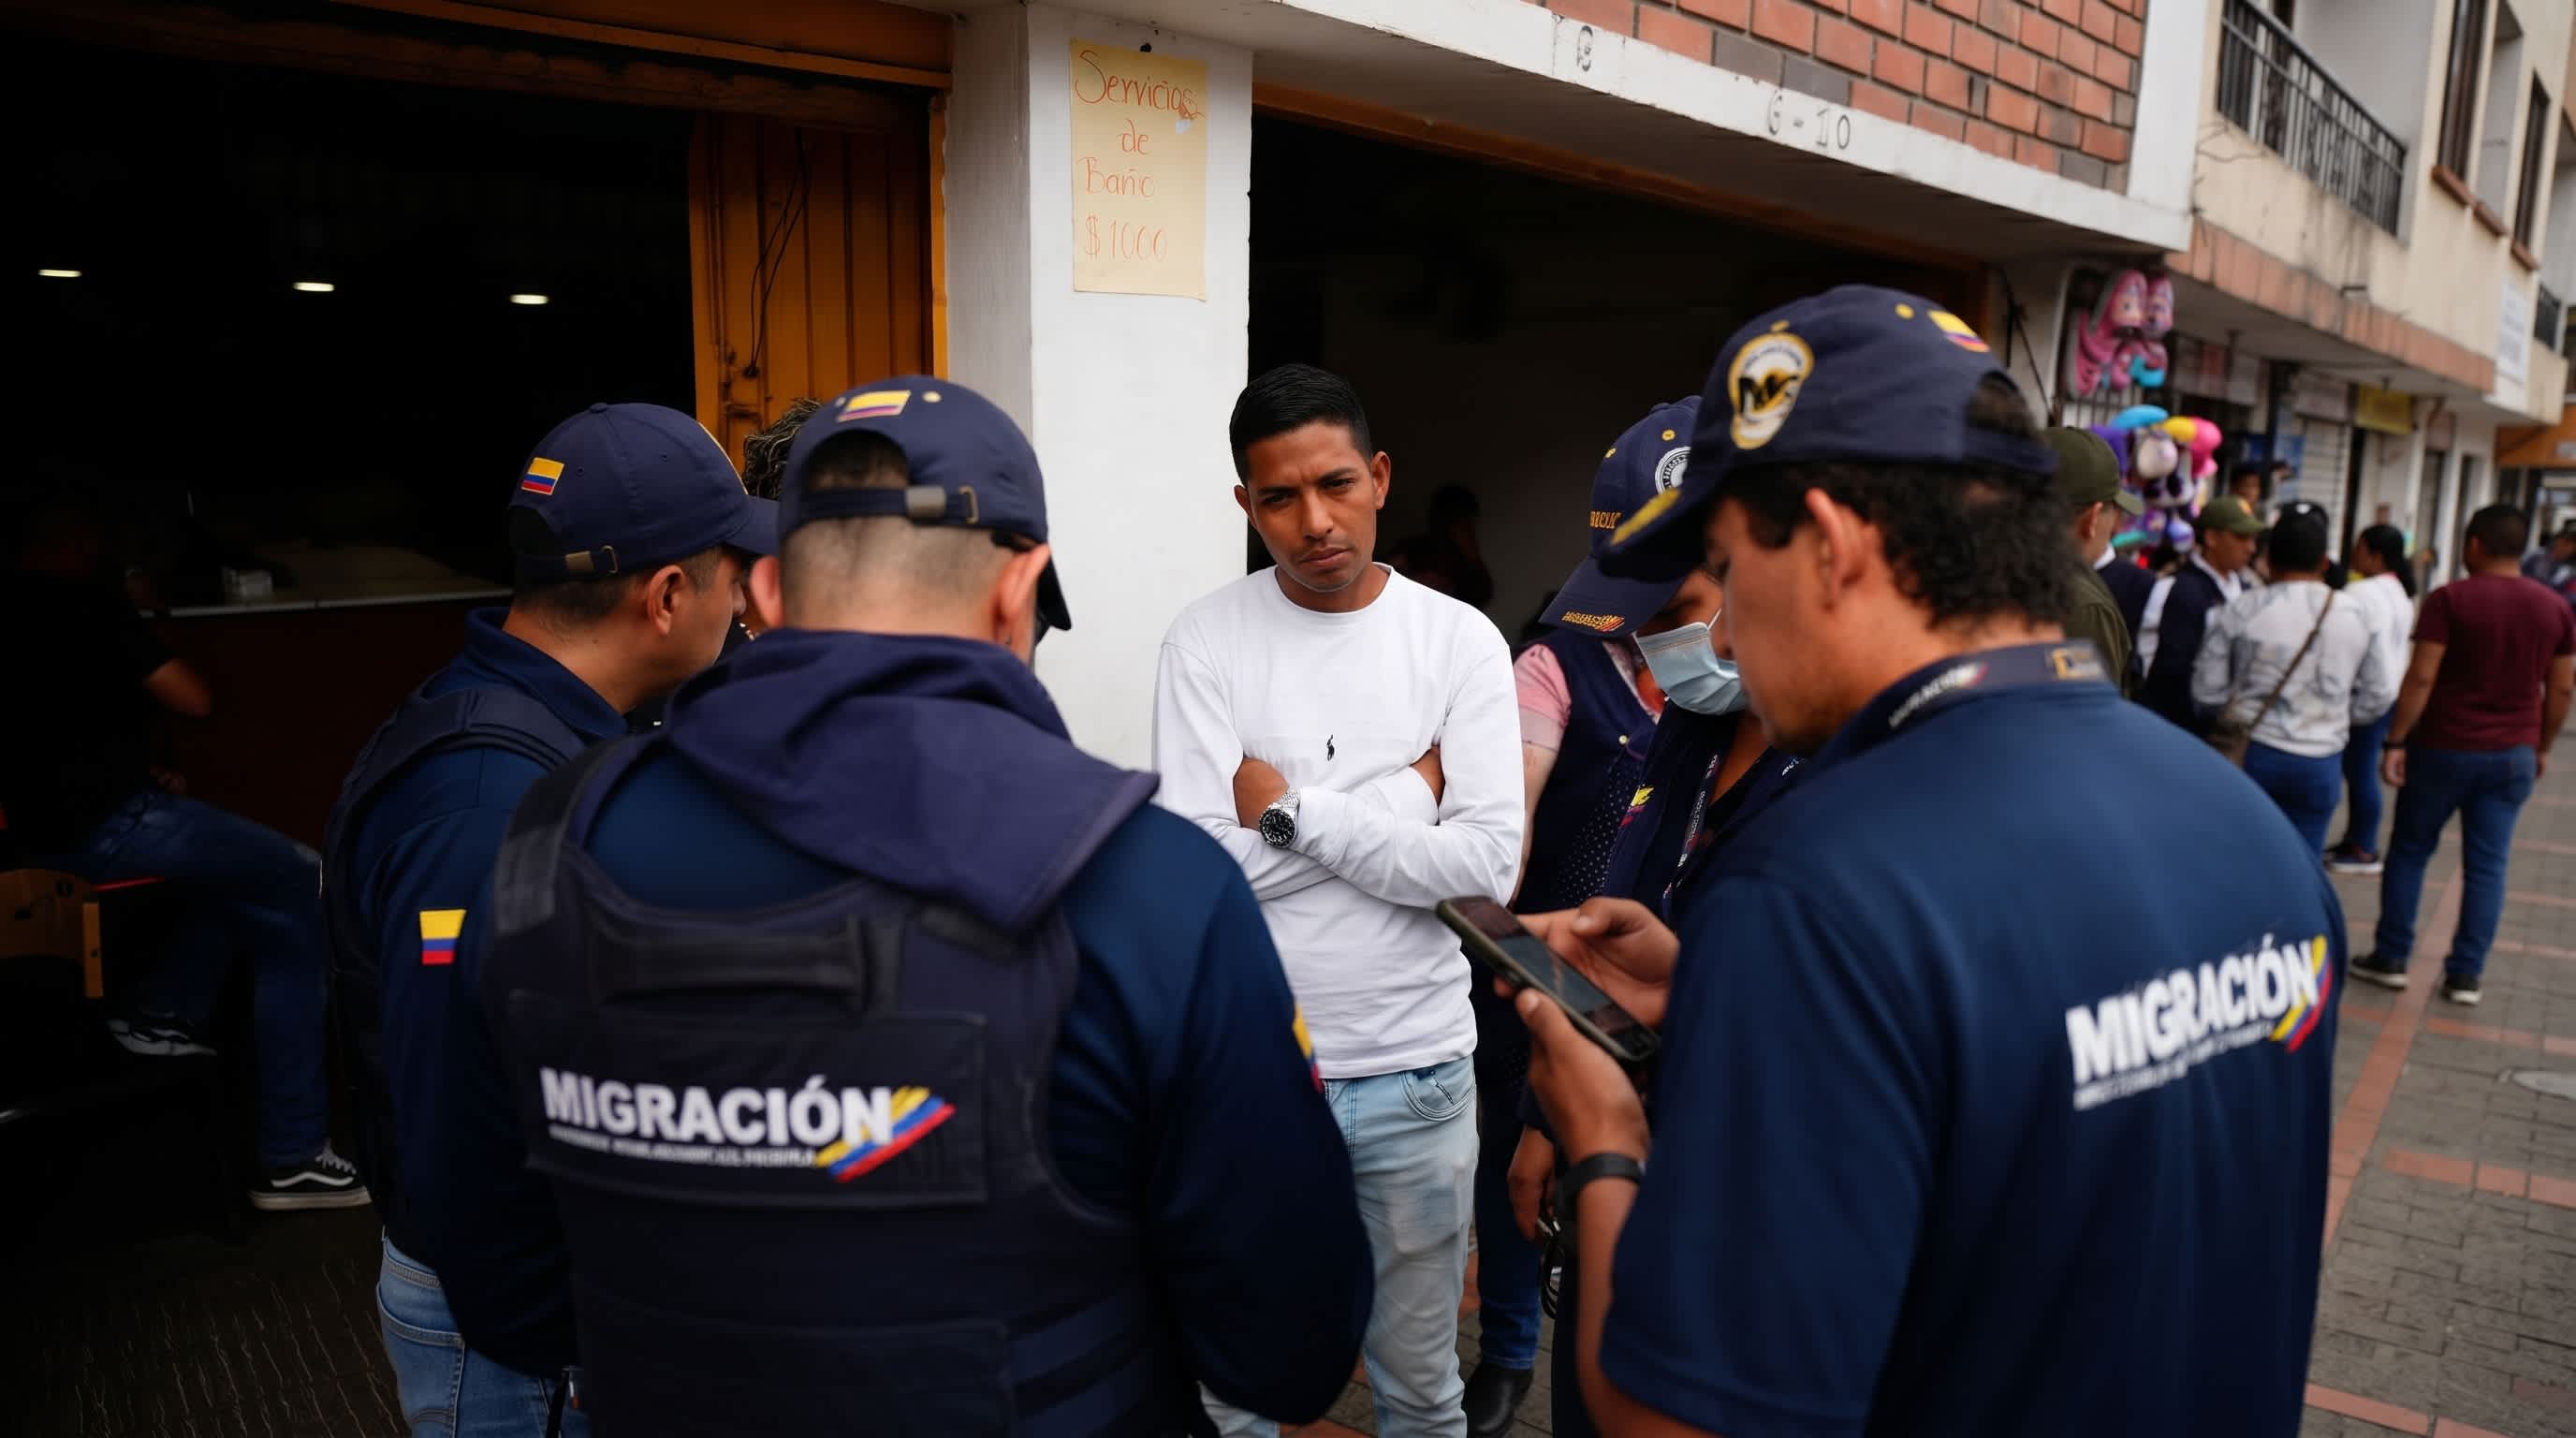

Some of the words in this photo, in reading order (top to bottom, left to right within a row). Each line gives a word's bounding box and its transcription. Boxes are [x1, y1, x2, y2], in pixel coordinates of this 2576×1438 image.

[1117, 118, 1152, 155] de
[1076, 156, 1155, 198] Baño
[2065, 933, 2317, 1085] MIGRACIÓN
[540, 1067, 893, 1146] MIGRACIÓN
